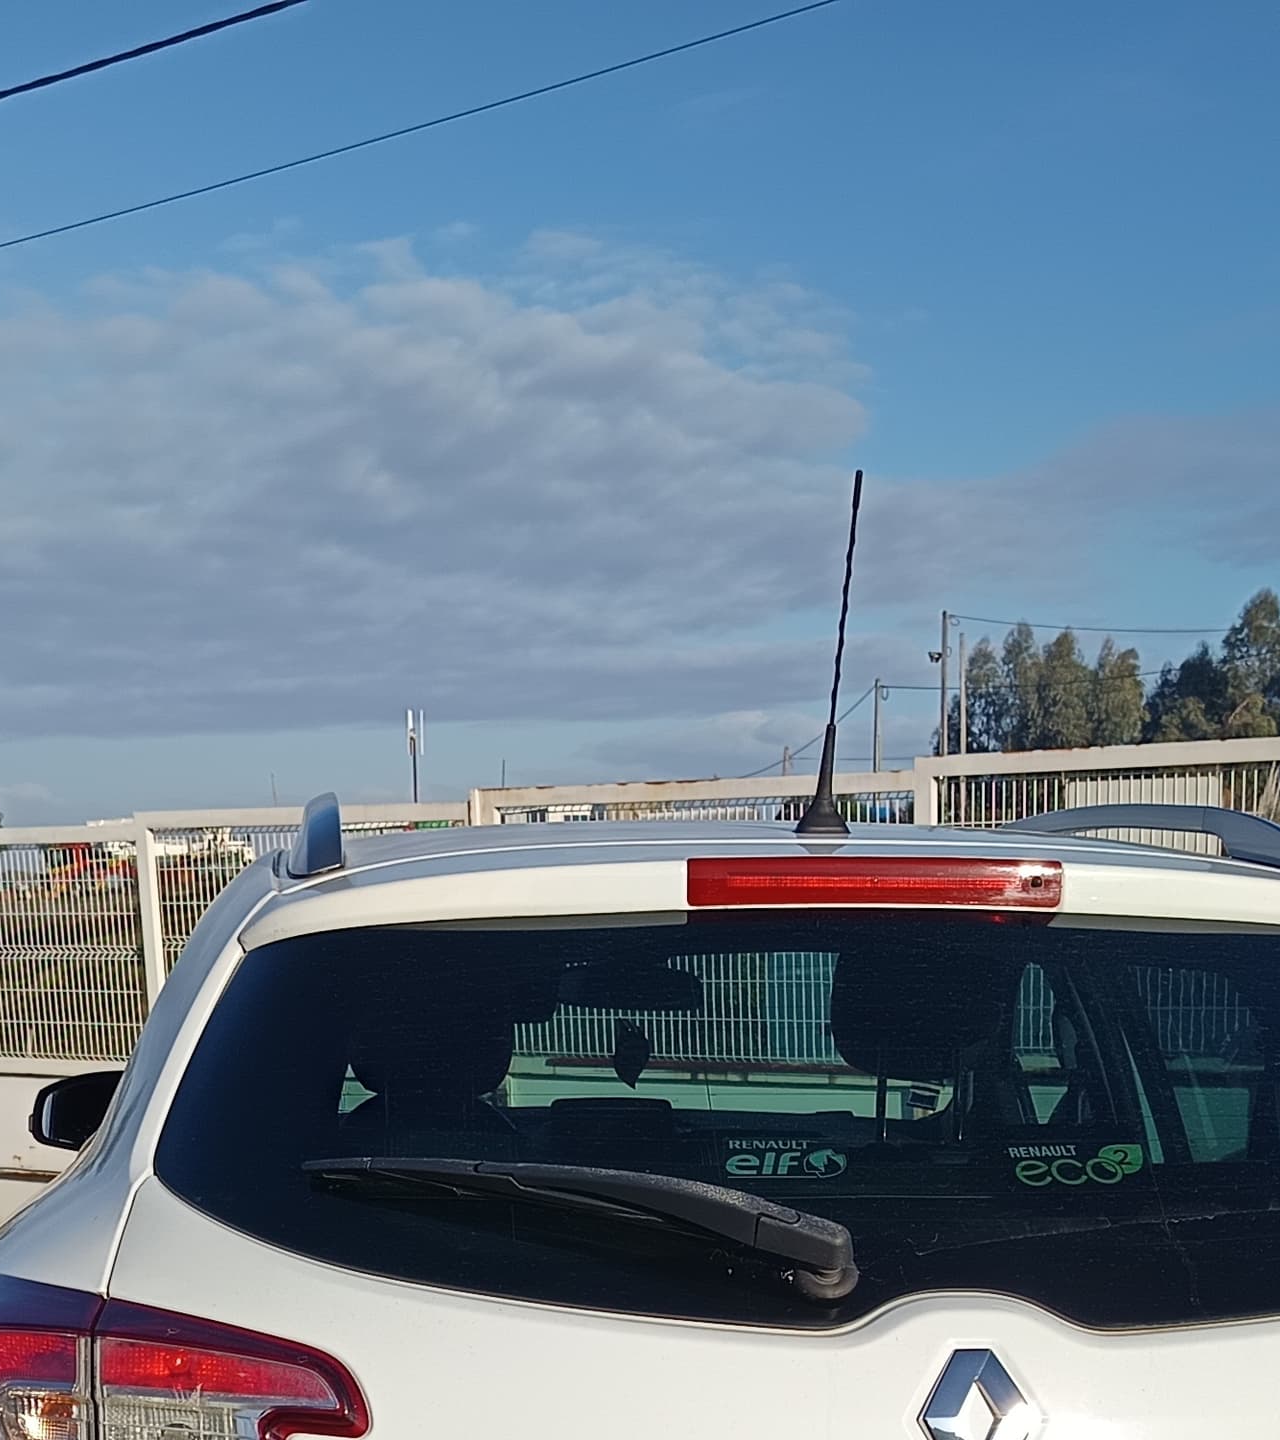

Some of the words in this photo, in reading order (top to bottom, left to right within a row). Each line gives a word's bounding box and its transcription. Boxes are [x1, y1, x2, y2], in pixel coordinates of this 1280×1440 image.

[728, 1140, 809, 1150] RENAULT
[1008, 1145, 1077, 1159] RENAULT
[725, 1152, 800, 1175] elf
